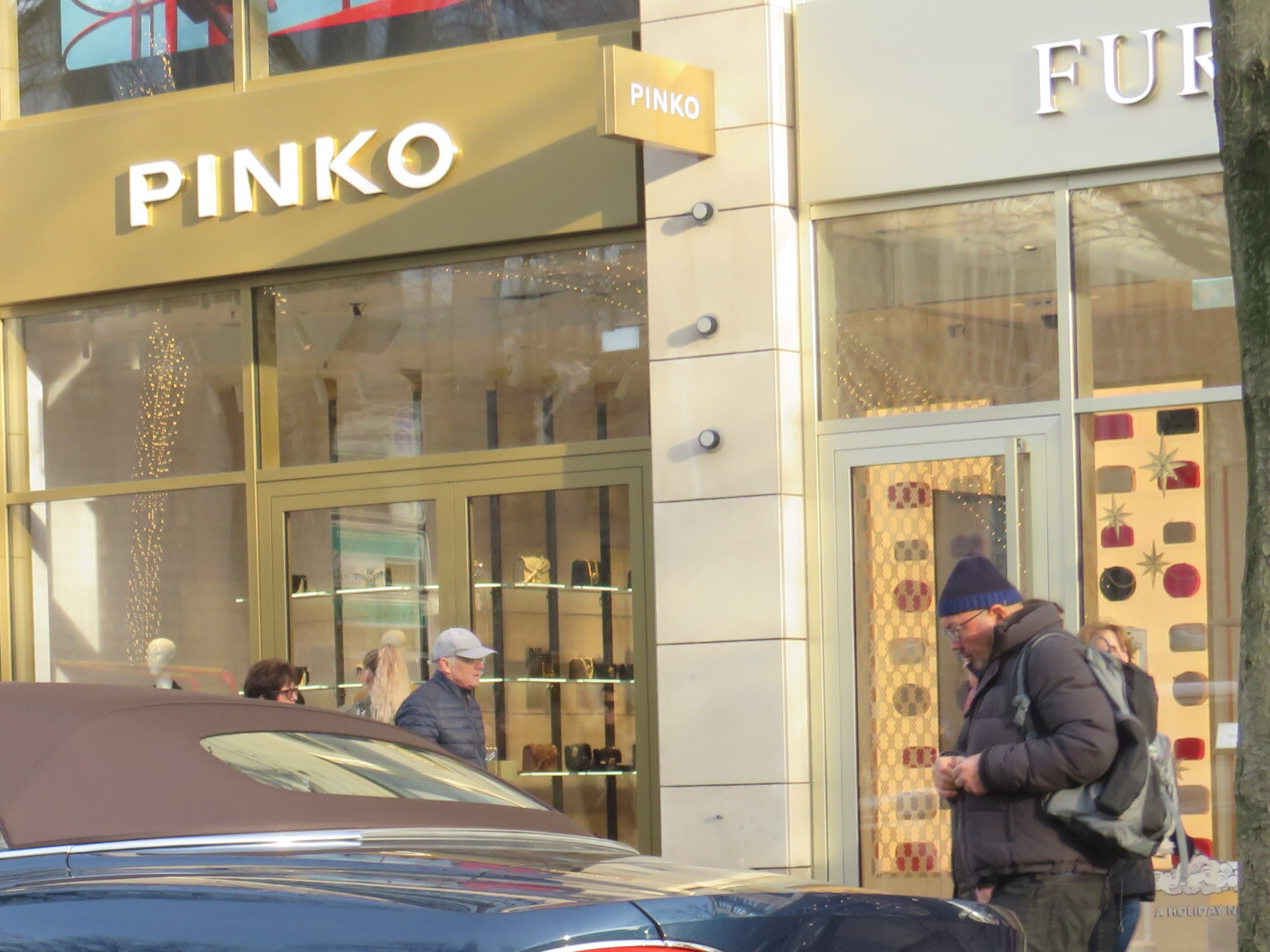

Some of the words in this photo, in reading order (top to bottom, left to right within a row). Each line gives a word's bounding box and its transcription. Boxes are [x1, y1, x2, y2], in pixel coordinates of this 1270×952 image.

[631, 82, 700, 120] PINKO
[129, 122, 461, 227] PINKO
[1154, 908, 1164, 918] A
[1167, 906, 1222, 918] HOLIDAY
